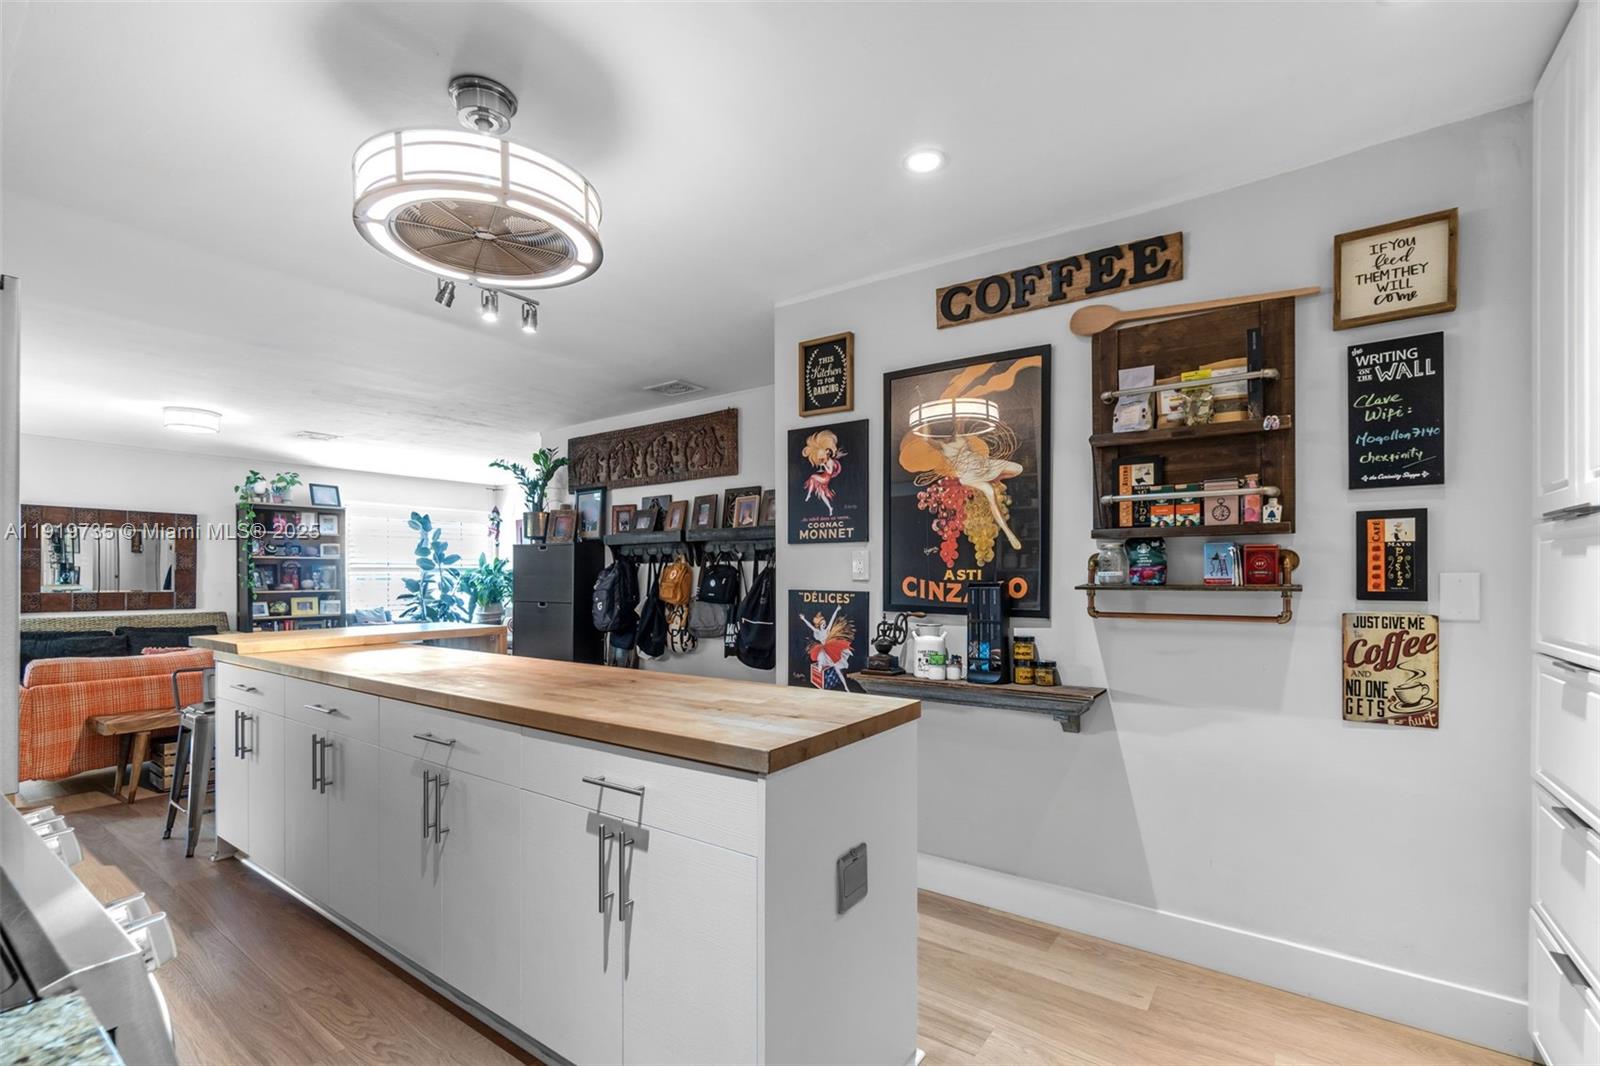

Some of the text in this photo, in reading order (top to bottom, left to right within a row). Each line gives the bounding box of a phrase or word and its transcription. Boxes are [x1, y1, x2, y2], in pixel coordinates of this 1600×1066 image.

[1369, 236, 1416, 255] IF YOU
[940, 235, 1171, 322] COFFEE
[1355, 262, 1429, 285] THEM THEY
[1376, 278, 1413, 292] WILL
[1374, 290, 1418, 305] come
[819, 355, 834, 364] THIS
[1356, 347, 1418, 367] WRITING
[810, 363, 842, 379] Kitchen
[1375, 358, 1436, 382] WALL
[813, 384, 839, 396] DANCING
[800, 528, 854, 540] MONNET
[943, 569, 982, 581] ASTI
[902, 576, 1028, 604] CINZO
[1353, 616, 1425, 630] JUST GIVE ME
[1345, 630, 1438, 672] Coffee
[1350, 670, 1372, 678] AND
[1345, 679, 1388, 699] NO ONE
[1345, 698, 1385, 717] GETS
[1408, 711, 1437, 727] hurt
